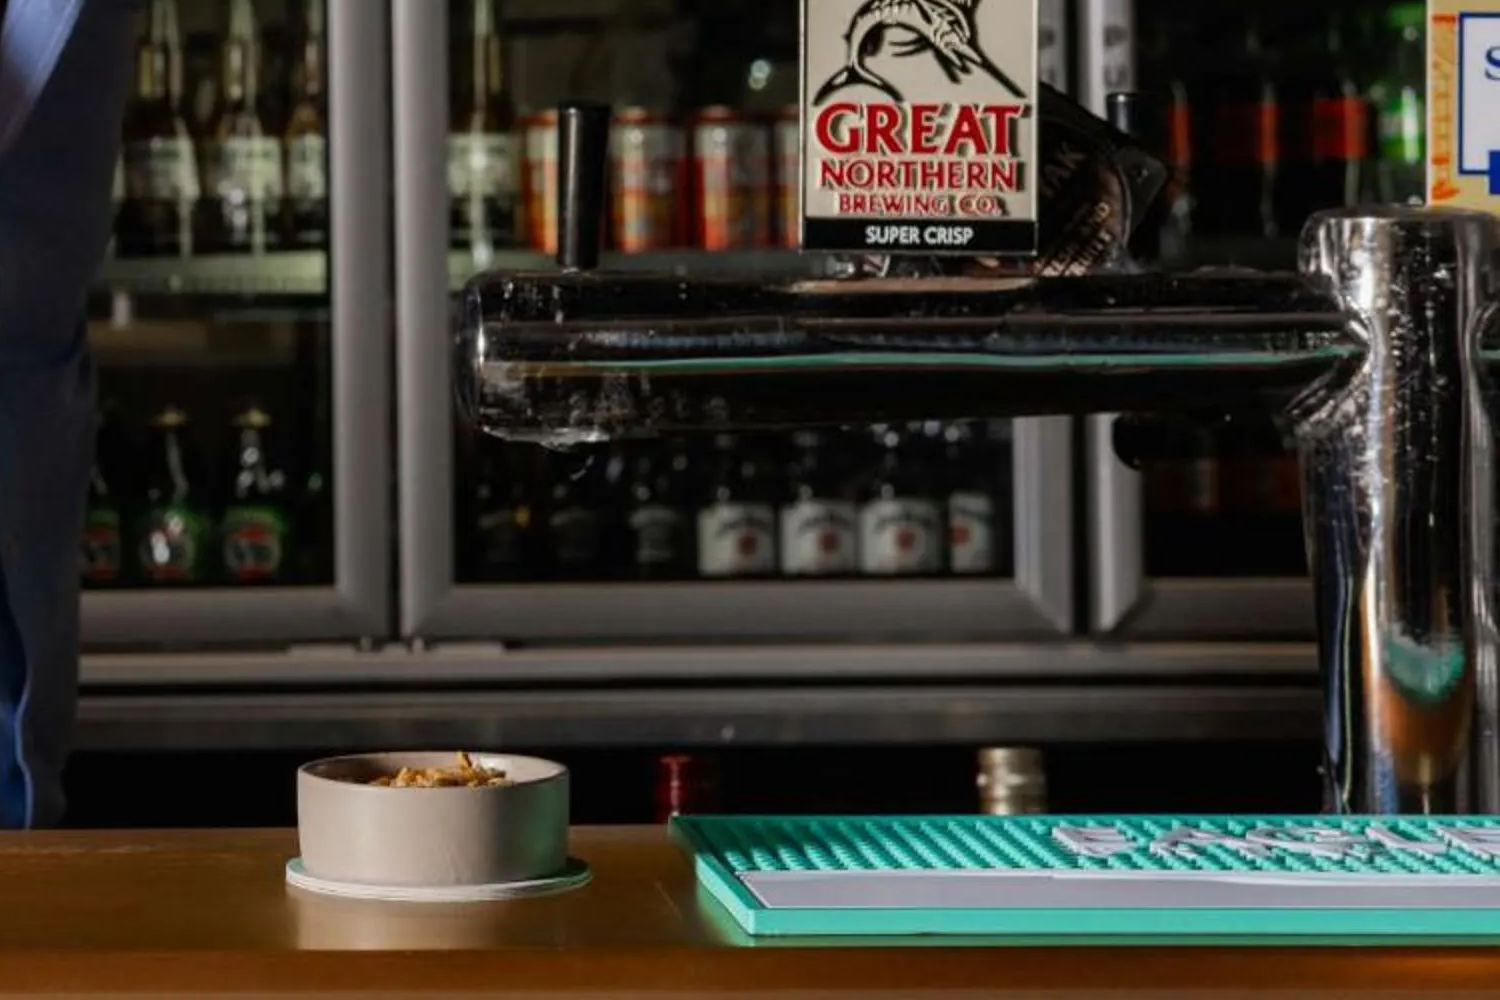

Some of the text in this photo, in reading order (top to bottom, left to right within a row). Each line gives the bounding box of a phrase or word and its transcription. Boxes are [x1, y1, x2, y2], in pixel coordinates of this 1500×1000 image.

[814, 102, 1027, 154] GREAT
[819, 159, 1022, 190] NORTHERN
[837, 194, 952, 215] BREWING
[864, 225, 974, 245] SUPER CRISP
